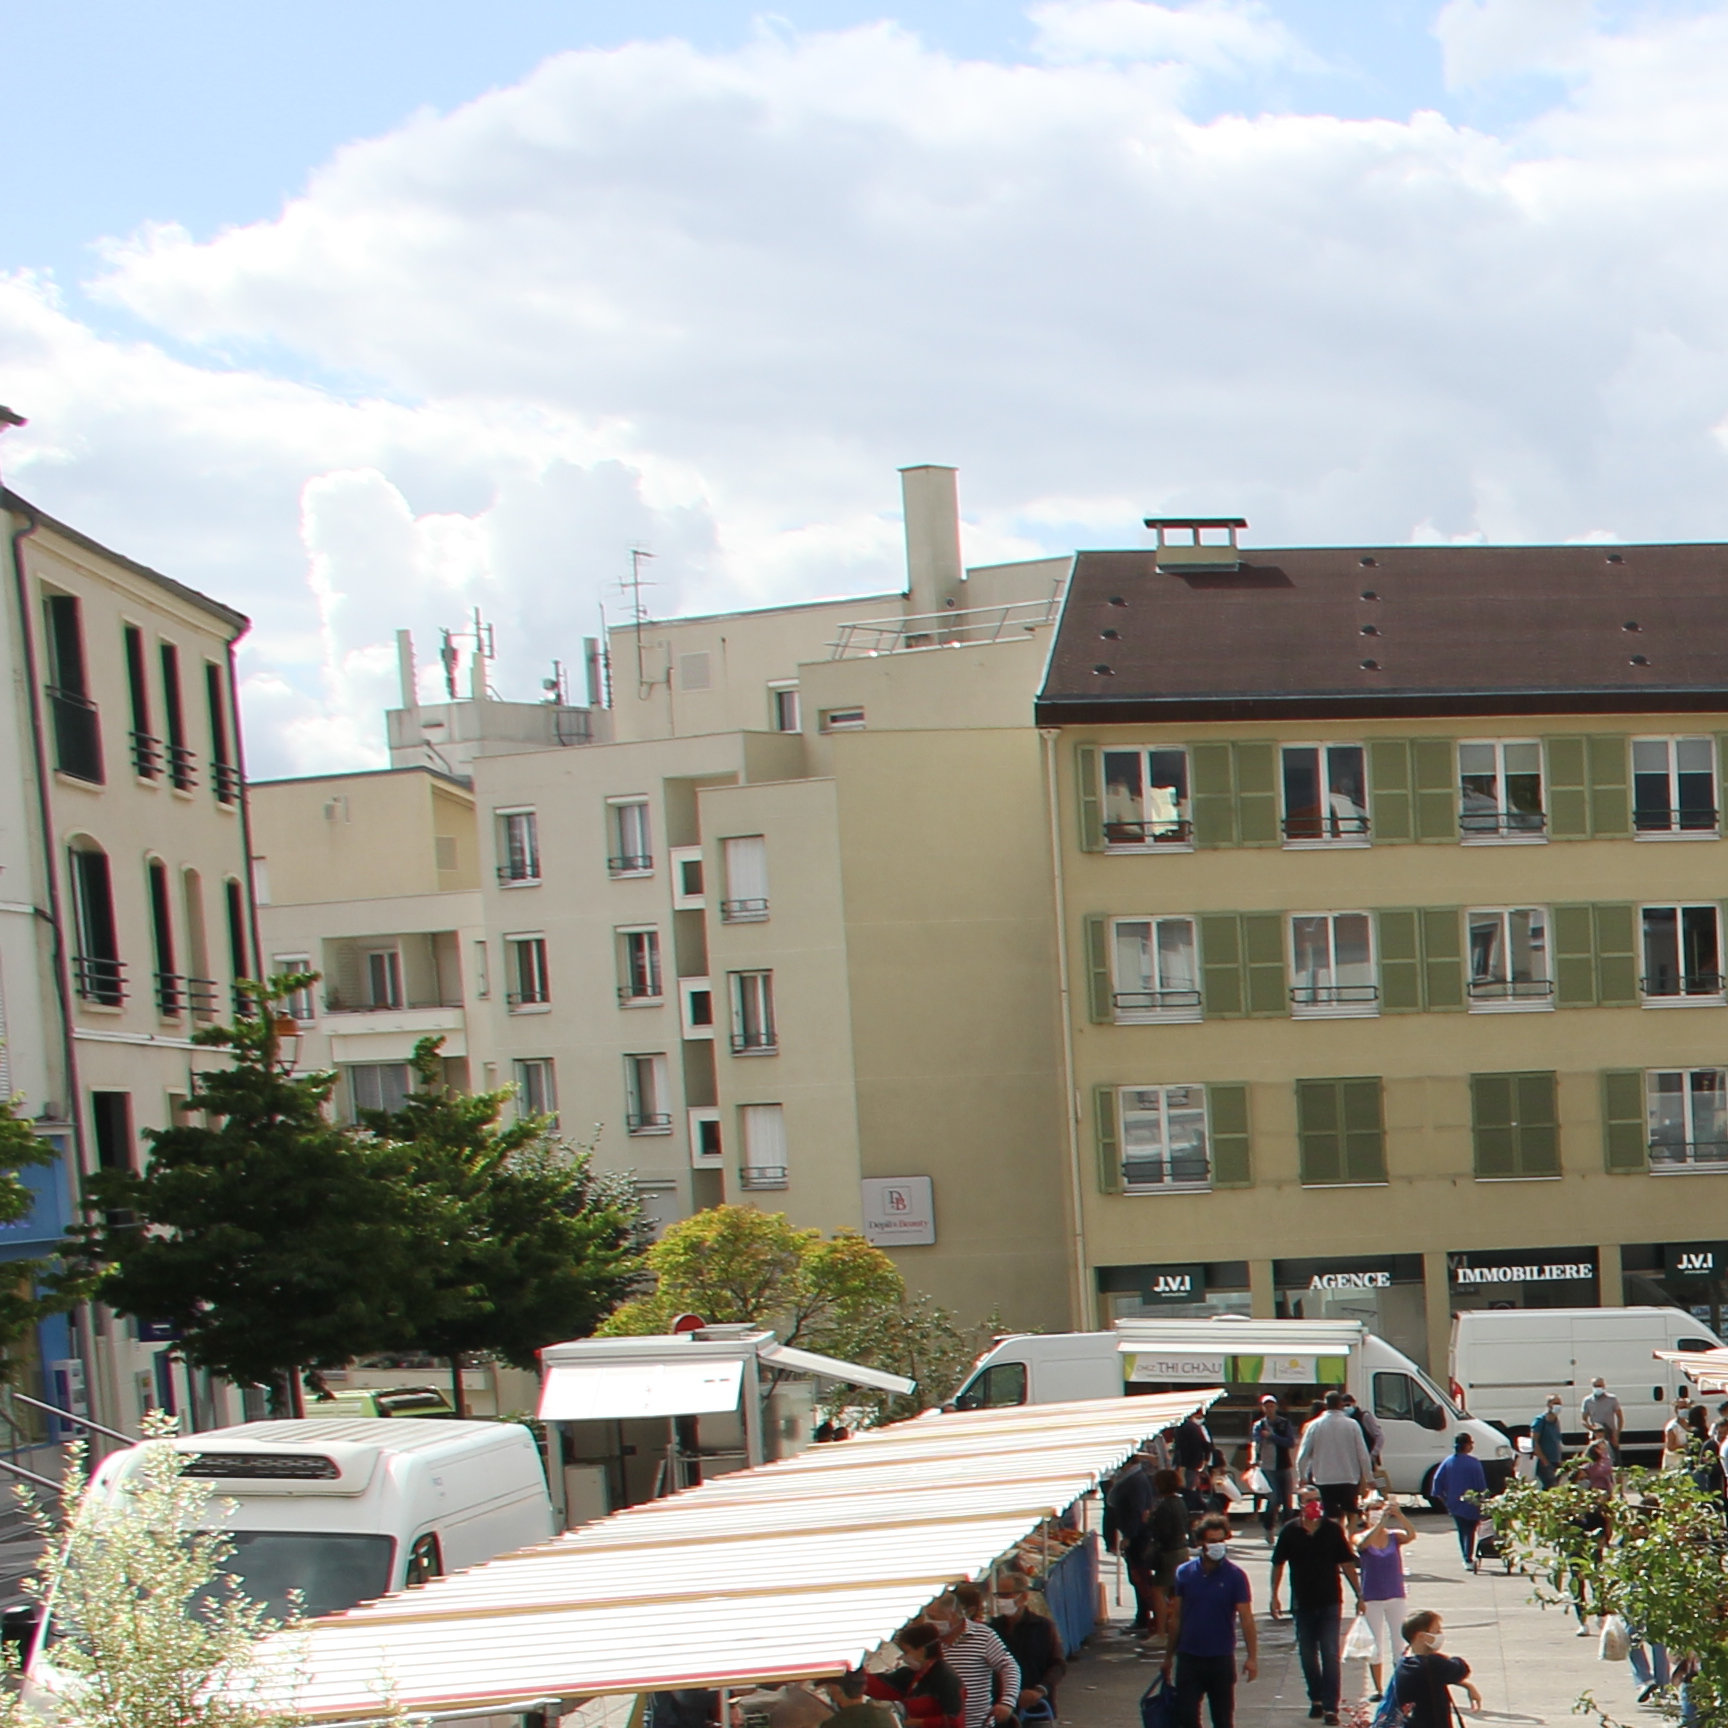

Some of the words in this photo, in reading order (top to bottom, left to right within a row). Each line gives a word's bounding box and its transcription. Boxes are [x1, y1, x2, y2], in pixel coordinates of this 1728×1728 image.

[1309, 1271, 1391, 1290] AGENCE
[1456, 1263, 1593, 1284] IMMOBILIERE
[1157, 1361, 1180, 1374] THI
[1181, 1361, 1222, 1375] CHAU
